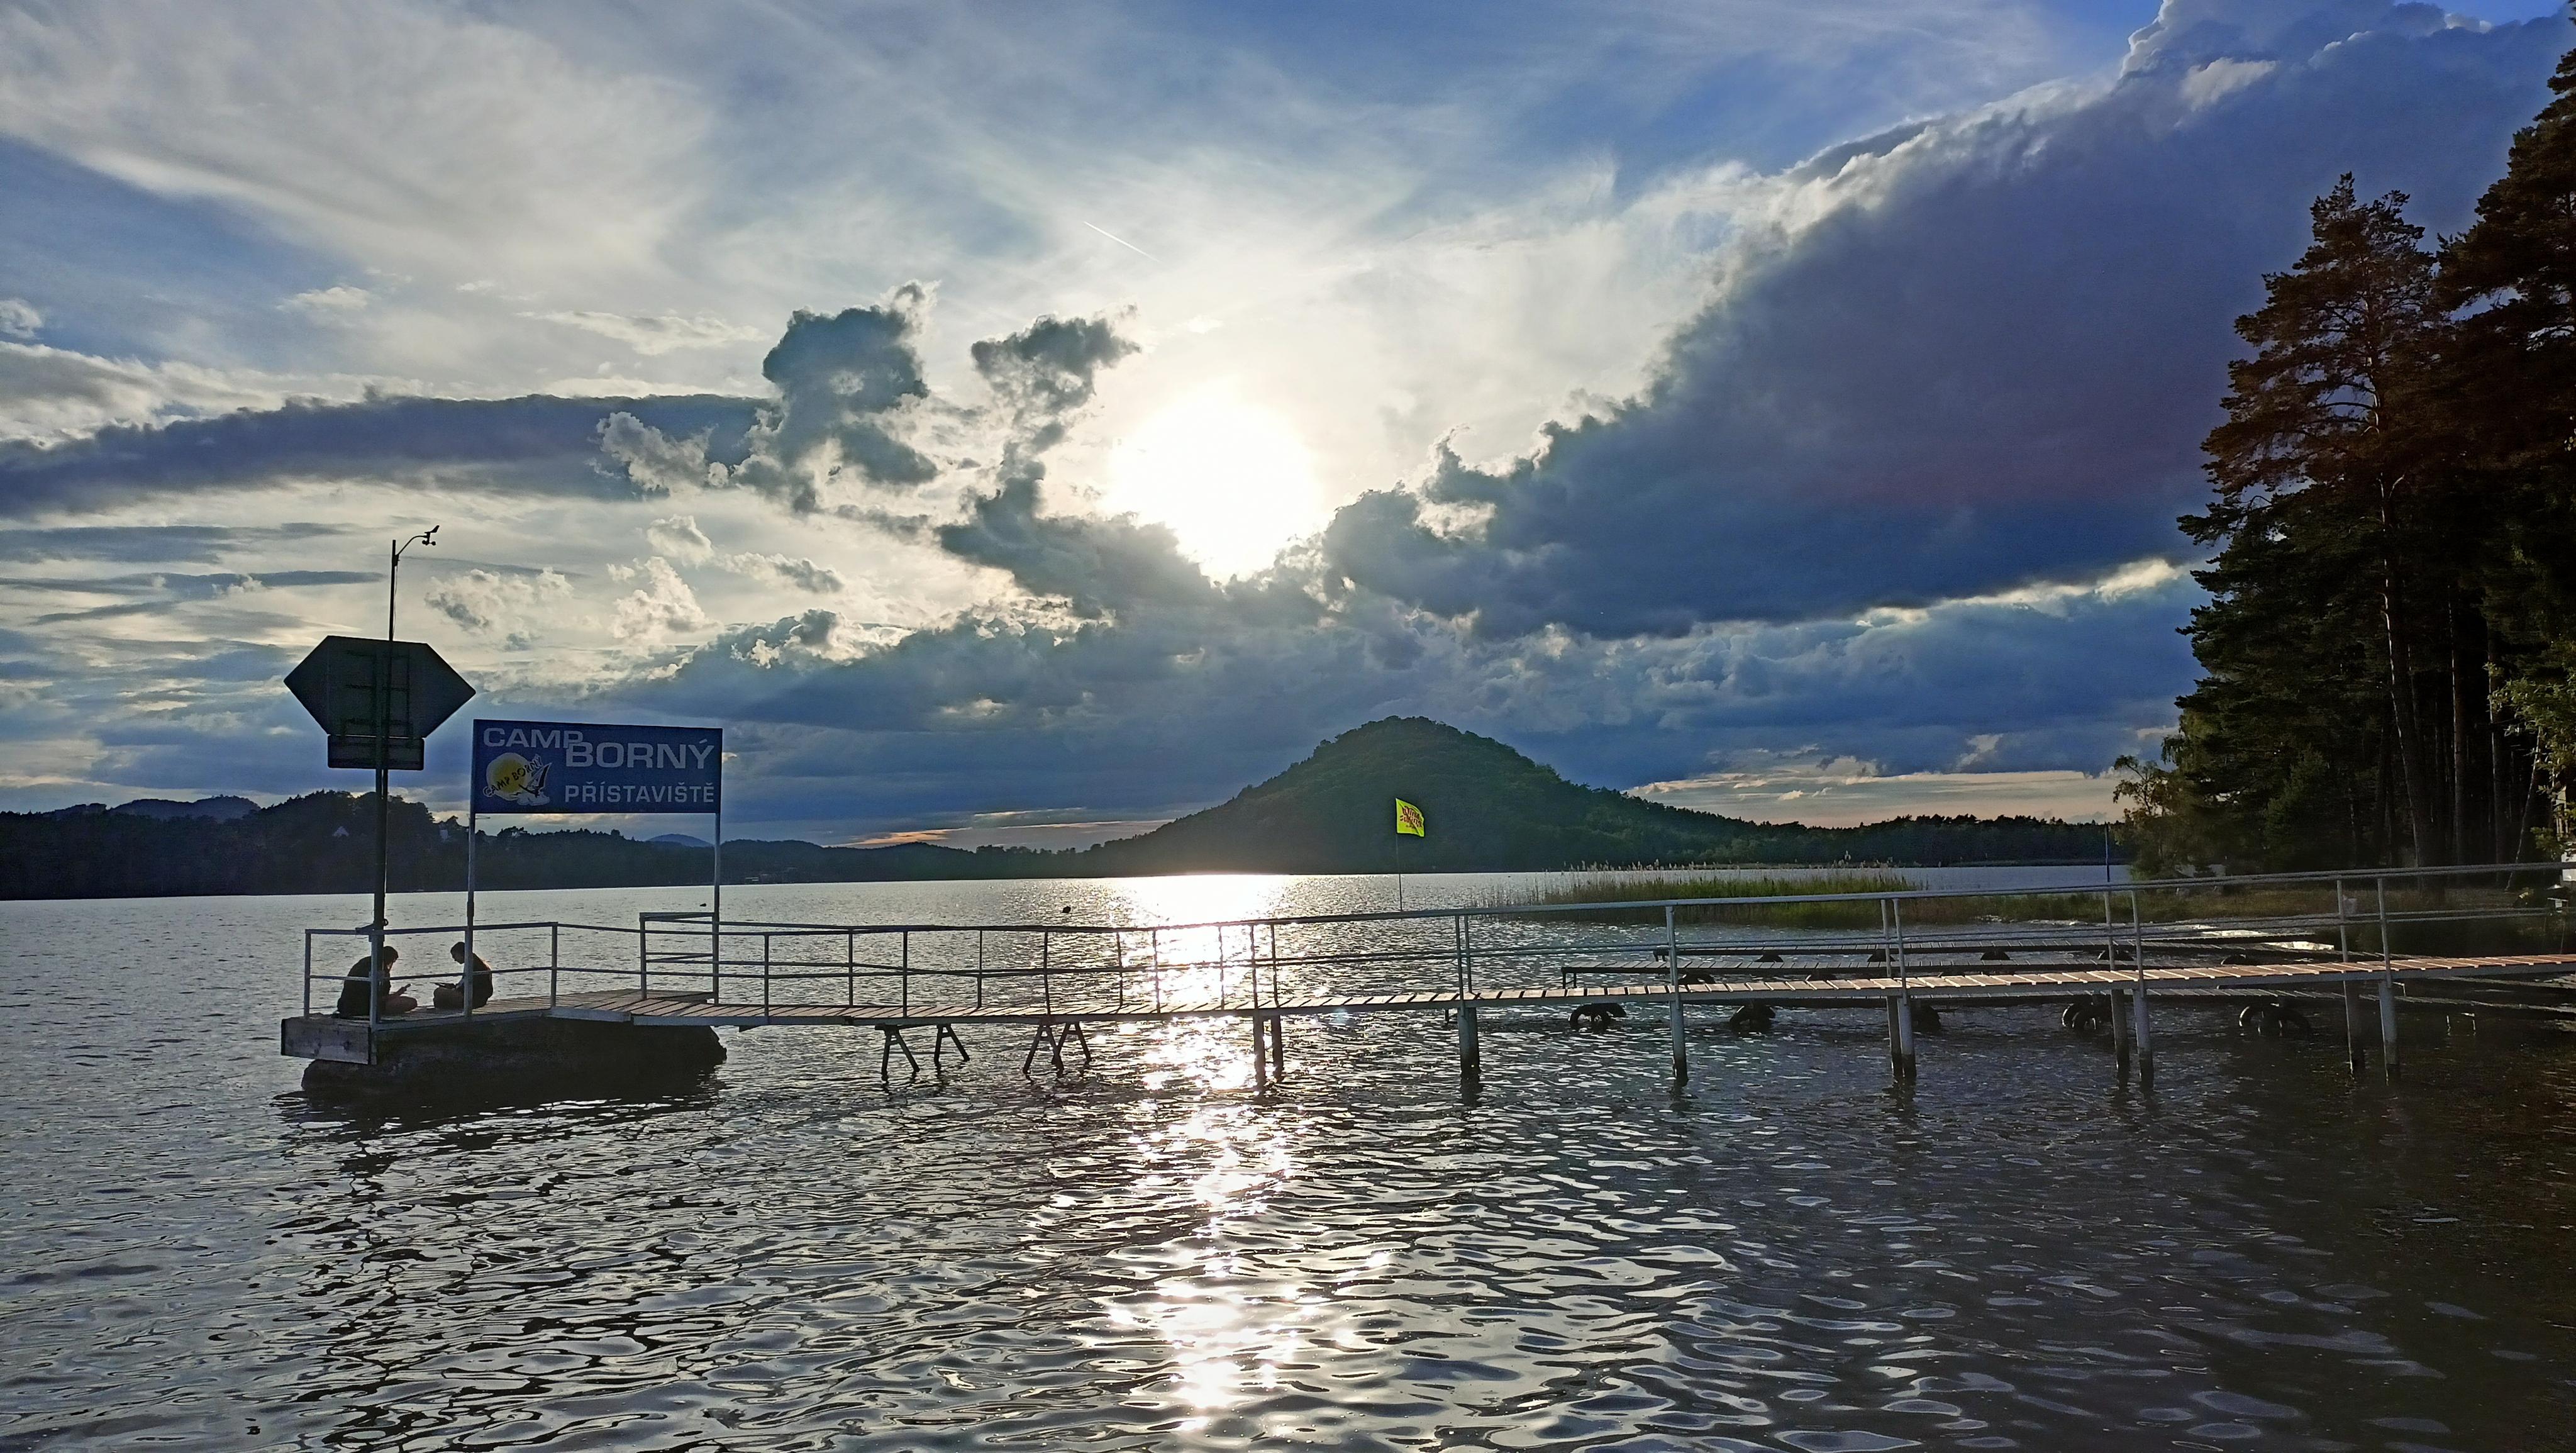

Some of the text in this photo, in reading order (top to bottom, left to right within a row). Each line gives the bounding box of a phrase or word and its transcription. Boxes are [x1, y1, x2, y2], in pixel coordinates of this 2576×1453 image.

[484, 728, 714, 769] CAMP BORNÝ
[483, 776, 510, 796] CAMP
[565, 781, 714, 803] PŘÍSTAVIŠTĚ
